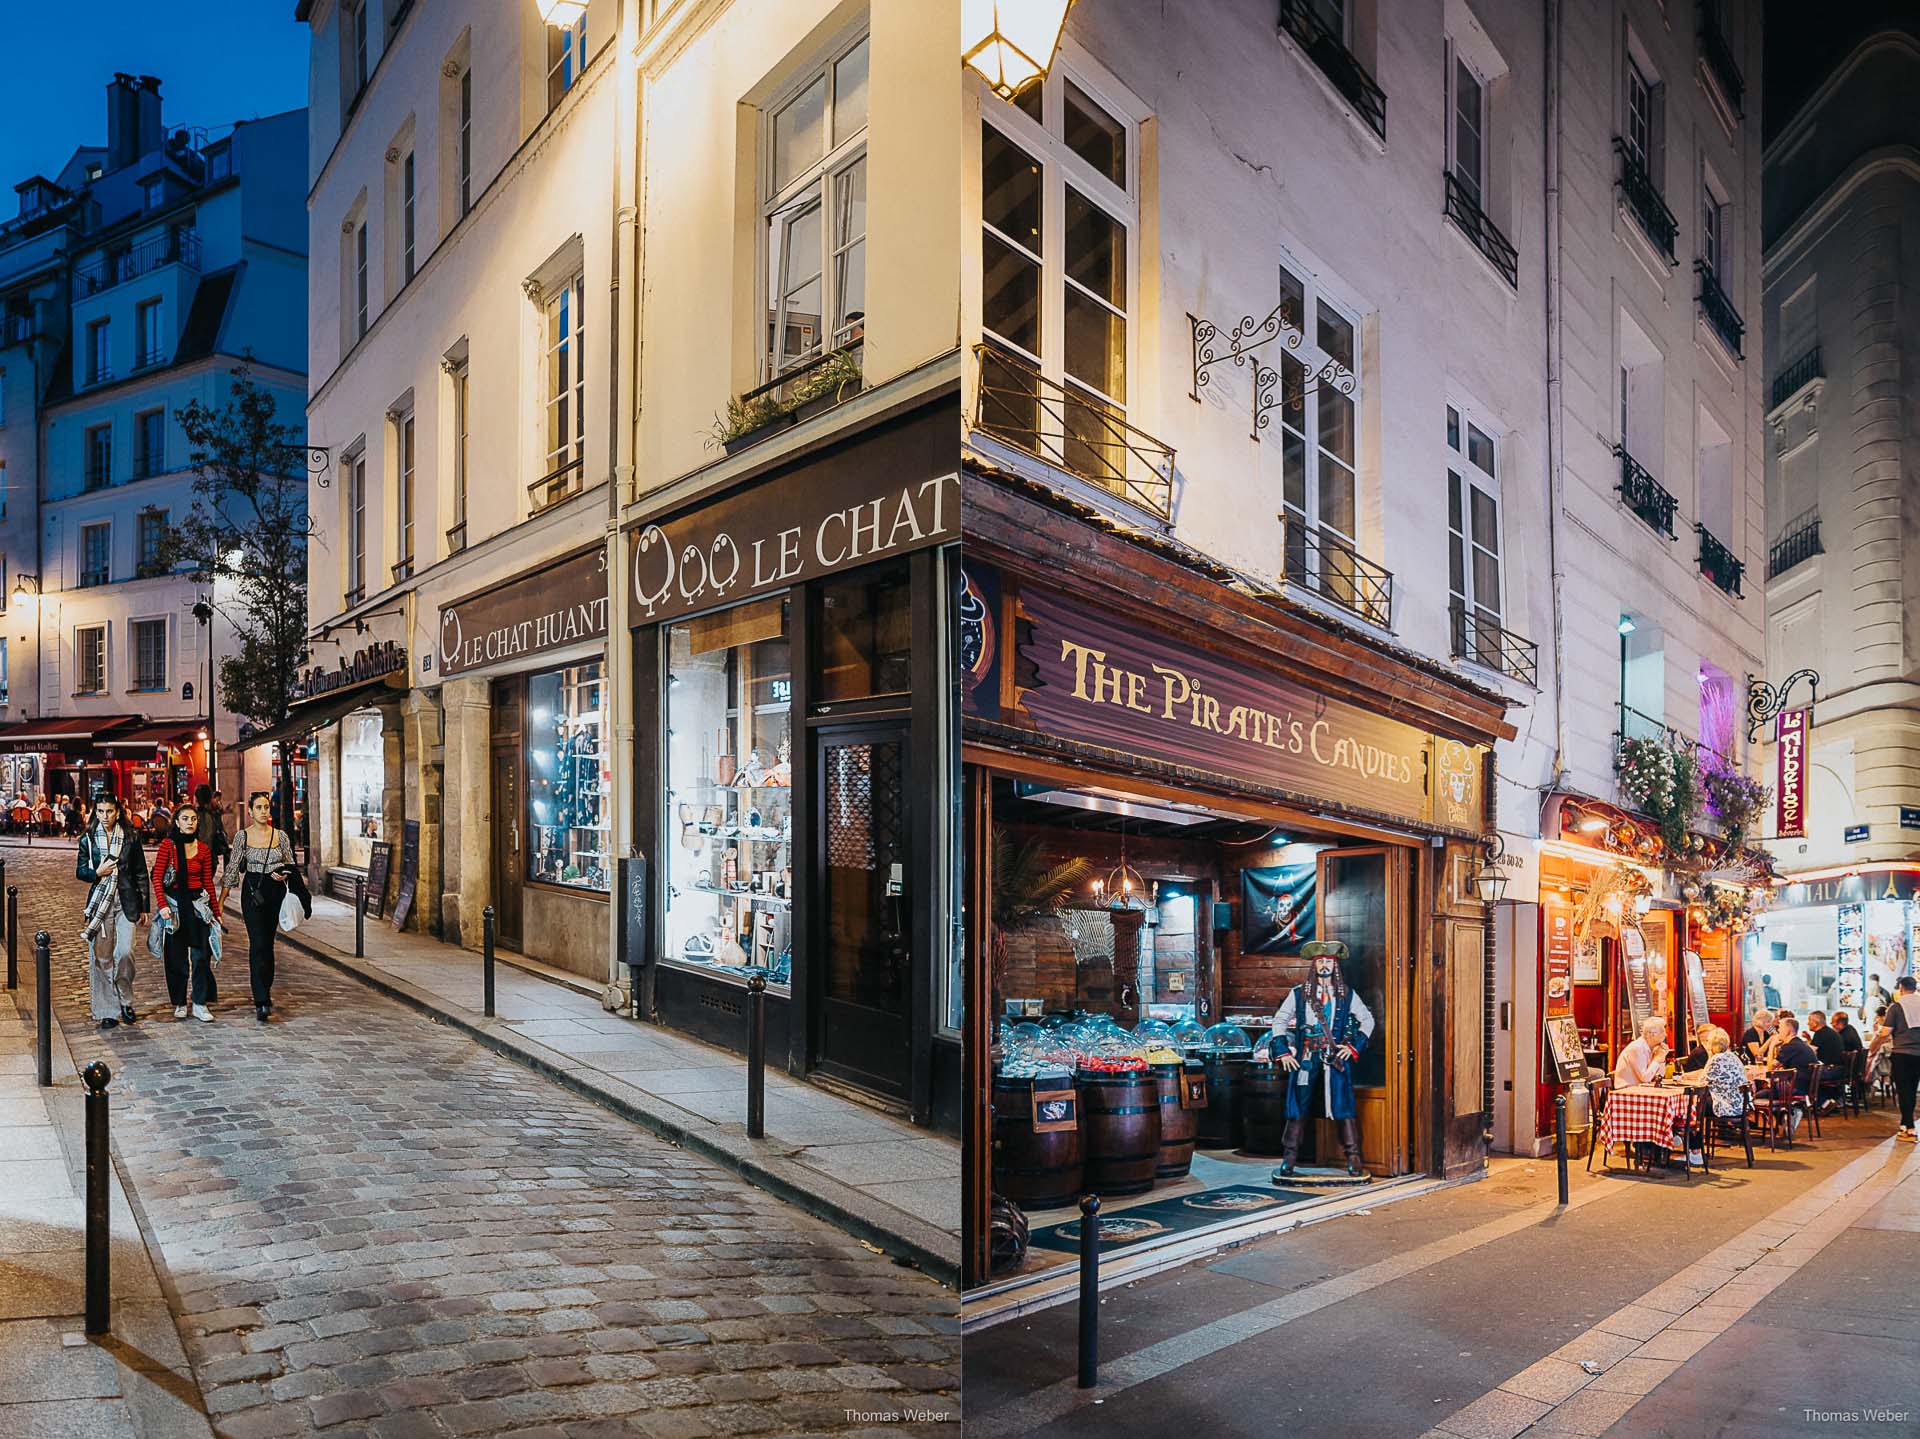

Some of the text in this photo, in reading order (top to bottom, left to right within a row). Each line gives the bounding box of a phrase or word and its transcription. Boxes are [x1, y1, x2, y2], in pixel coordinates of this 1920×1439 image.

[597, 550, 609, 573] 5
[751, 472, 961, 588] LE CHAT
[463, 596, 609, 667] LE CHAT HUANT
